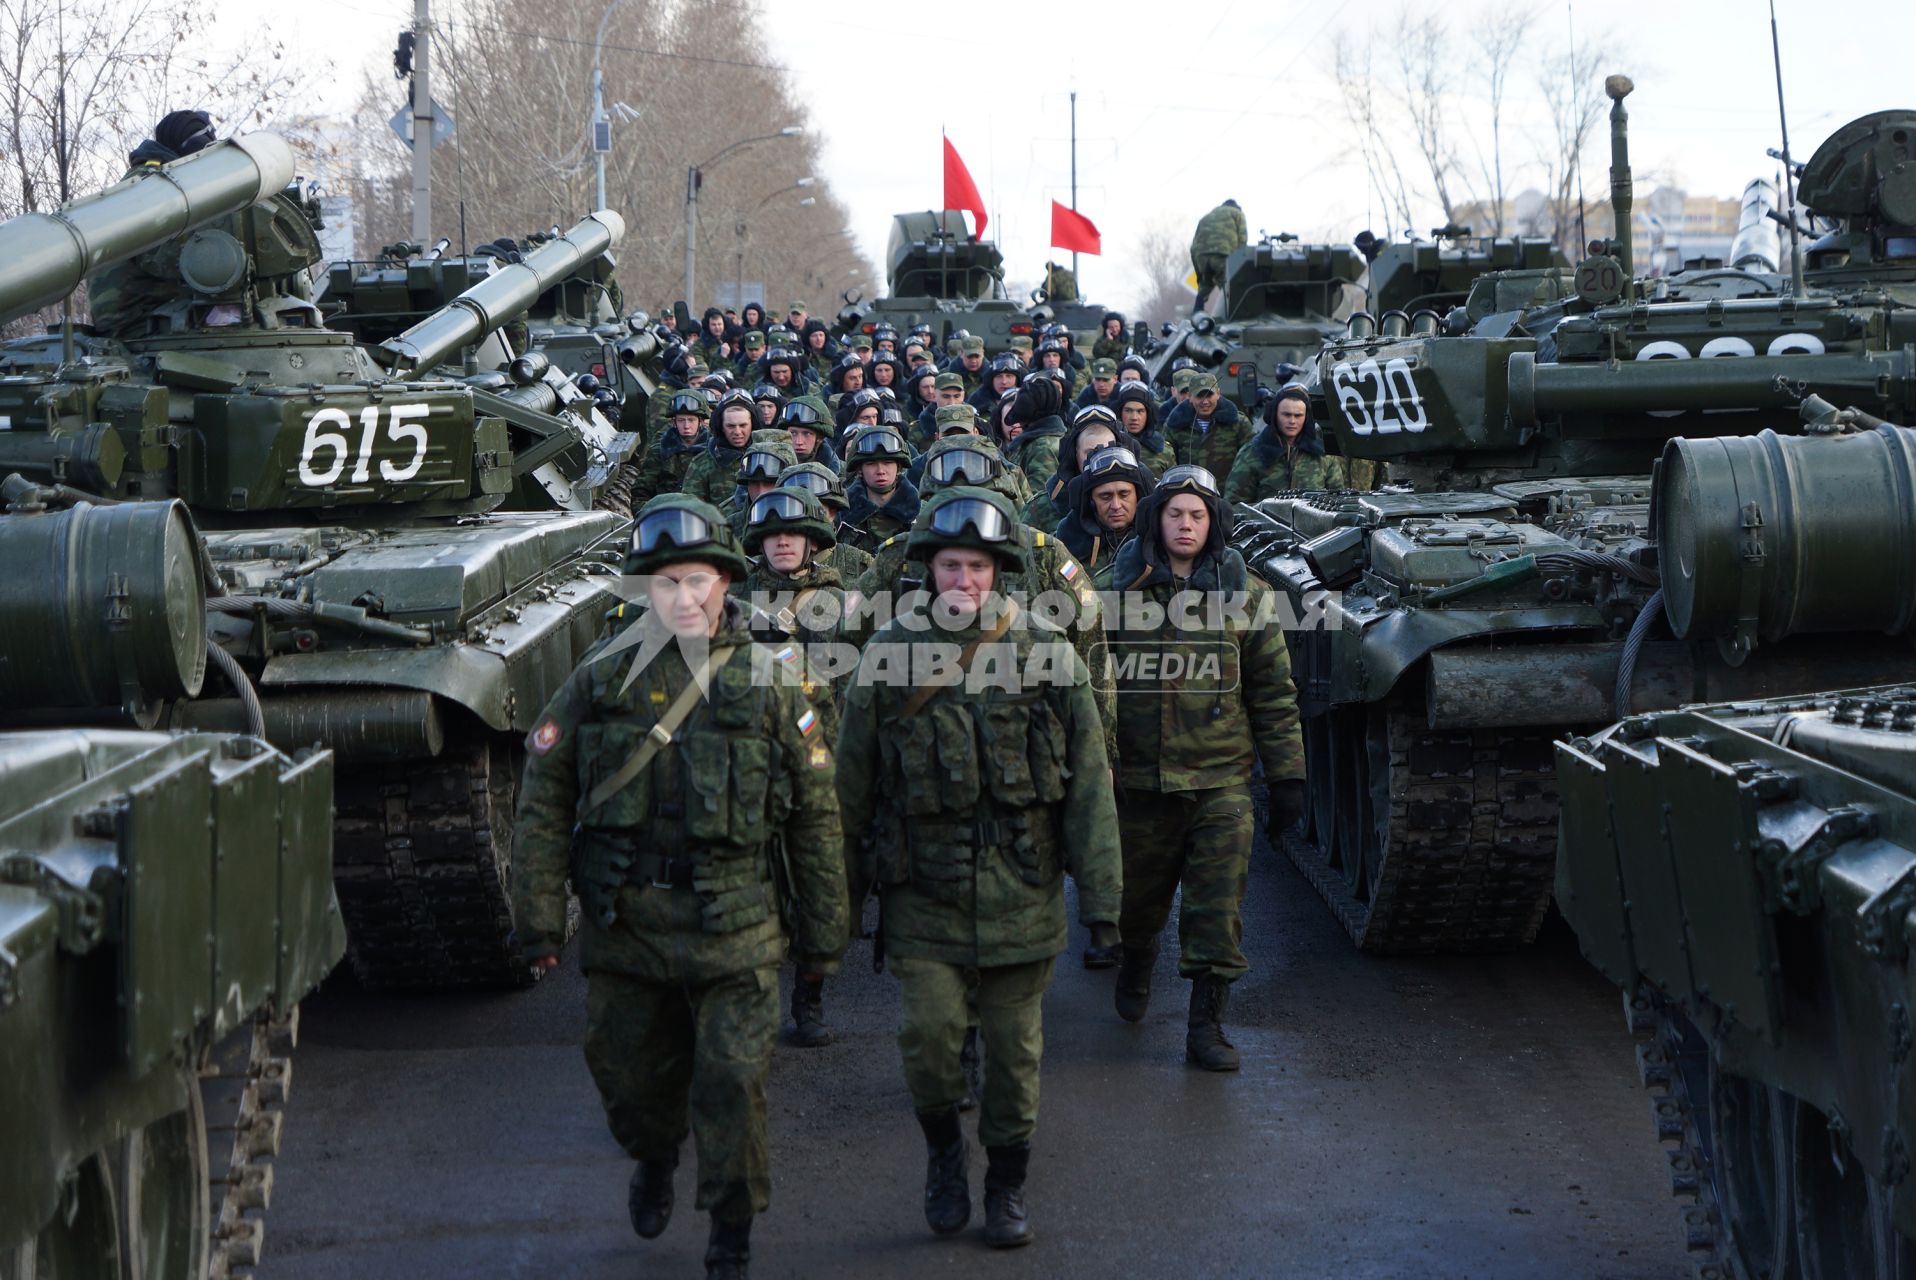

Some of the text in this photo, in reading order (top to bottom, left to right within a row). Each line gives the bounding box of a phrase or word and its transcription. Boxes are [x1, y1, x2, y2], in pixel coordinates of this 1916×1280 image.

[1583, 267, 1617, 292] 20
[1333, 358, 1427, 435] 620
[299, 403, 430, 486] 615
